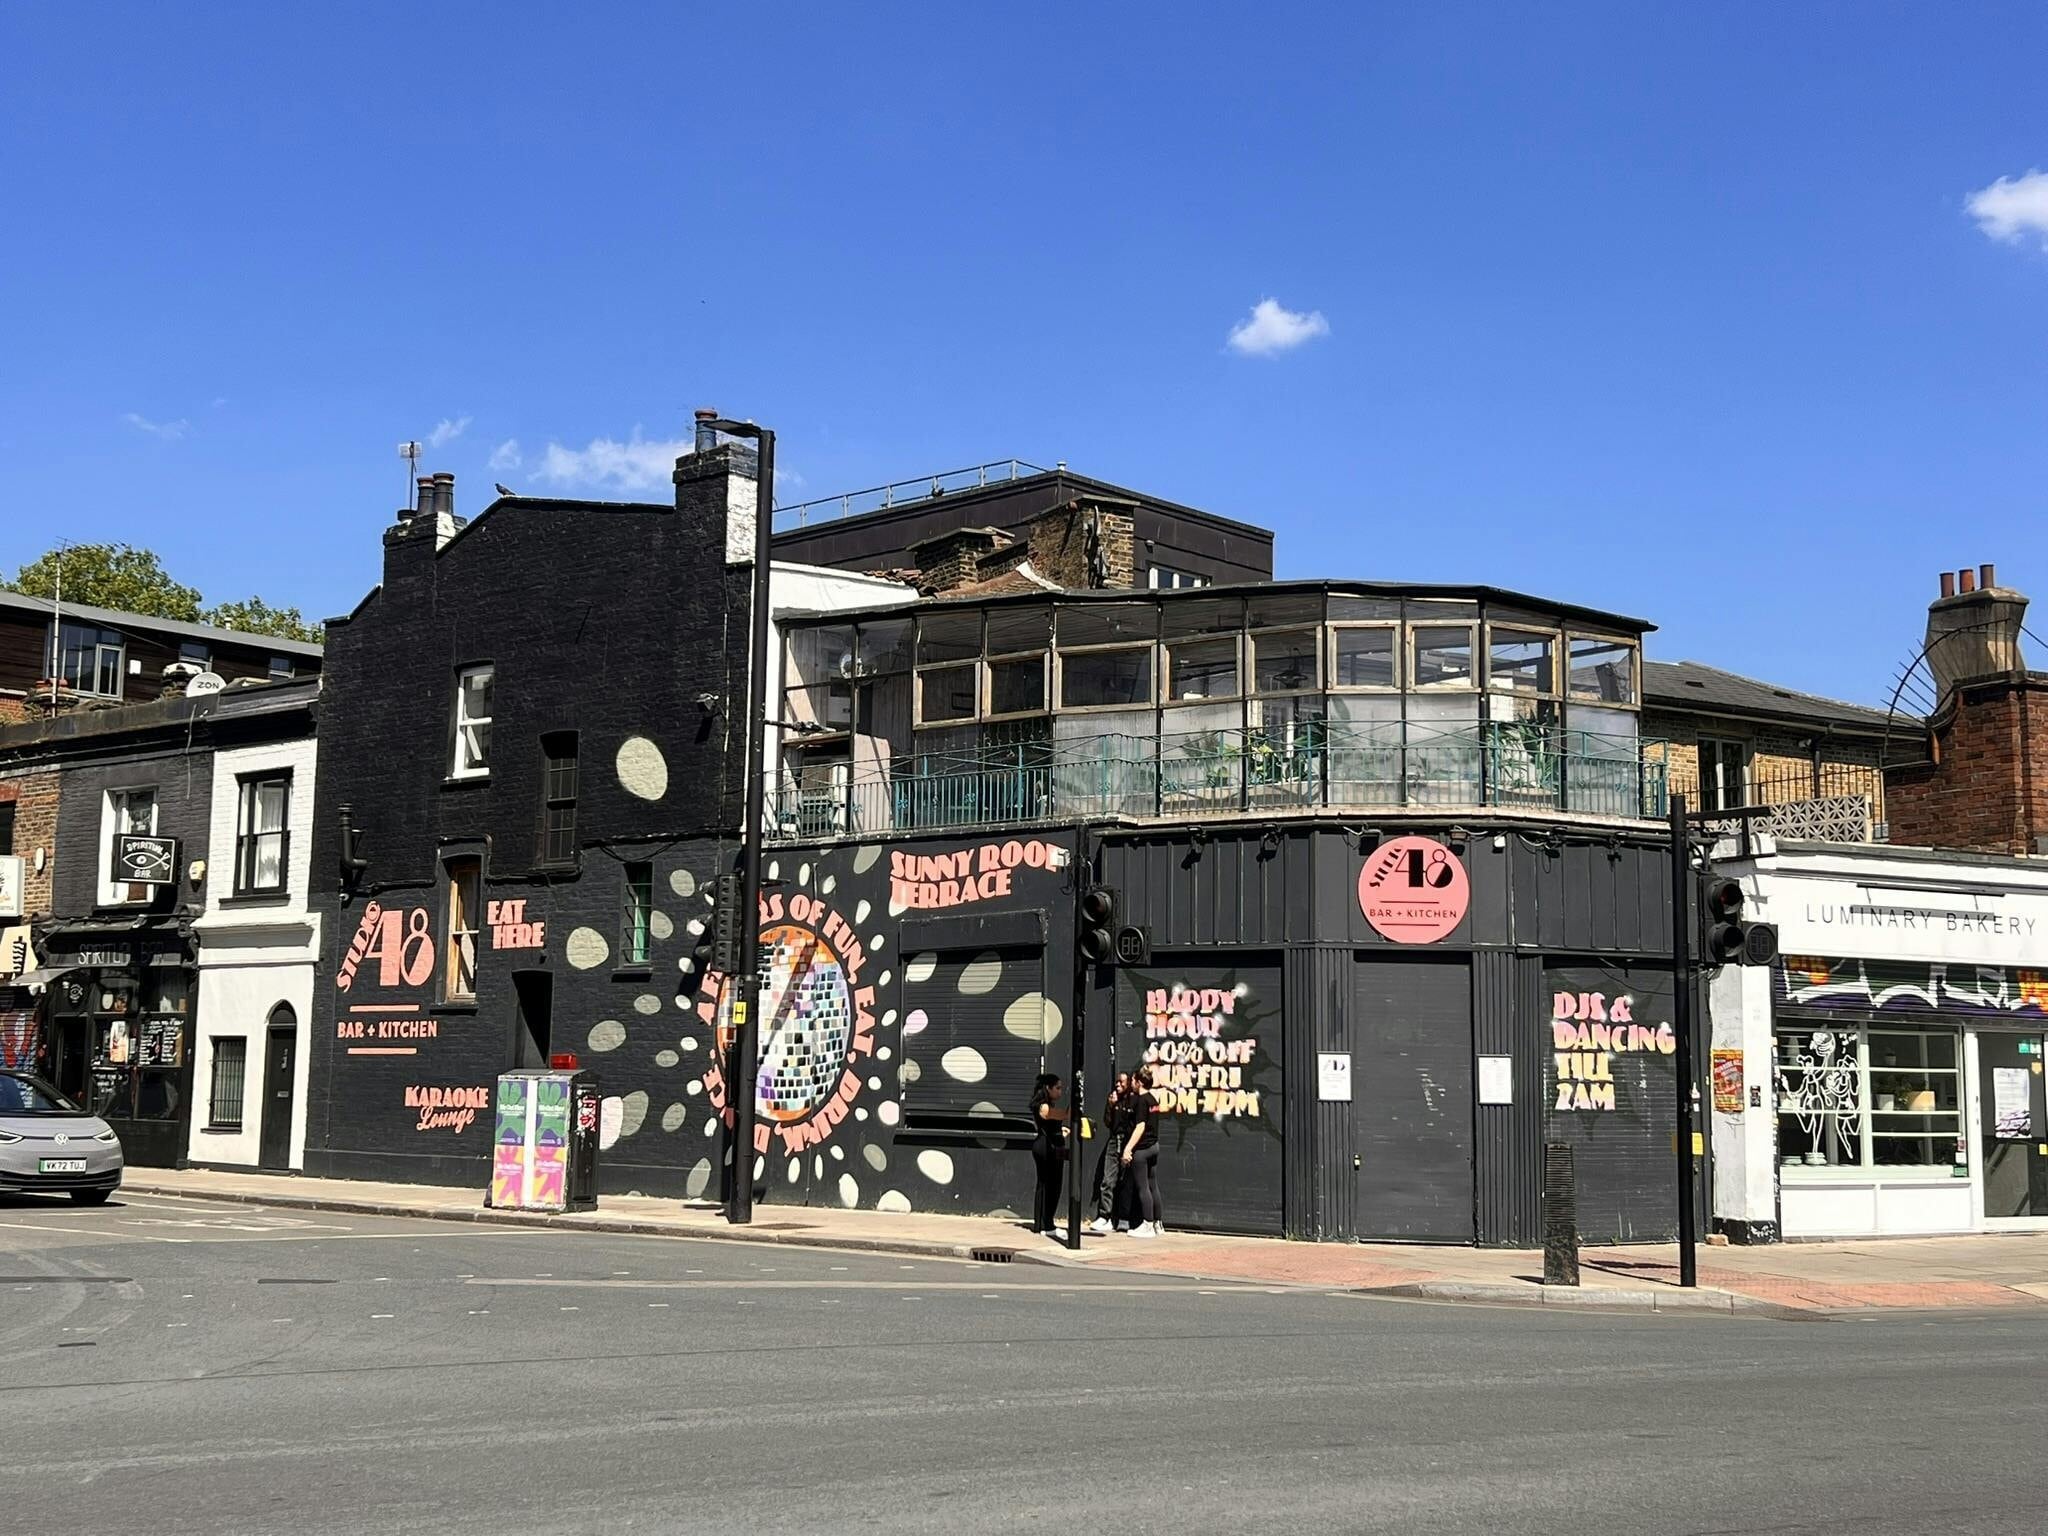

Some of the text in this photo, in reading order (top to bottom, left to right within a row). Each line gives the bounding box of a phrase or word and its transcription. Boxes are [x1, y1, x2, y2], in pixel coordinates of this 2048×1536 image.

[197, 681, 220, 690] ZON
[134, 869, 151, 878] BAR
[890, 850, 974, 882] SUNNY
[1395, 849, 1453, 888] 48
[889, 868, 1011, 909] TERRACE
[487, 899, 527, 925] EAT
[789, 893, 826, 927] OF
[1369, 908, 1392, 917] BAR
[1407, 909, 1457, 918] KITCHEN
[1806, 903, 2036, 936] LUMINARY BAKERY
[336, 900, 435, 993] STUDIO 48
[493, 922, 545, 949] HERE
[1146, 988, 1237, 1014] HAPPY
[1609, 994, 1634, 1022] &
[337, 1021, 364, 1038] BAR
[378, 1020, 437, 1038] KITCHEN
[1145, 1013, 1221, 1040] HOUR
[1552, 1020, 1677, 1054] DANCING
[1143, 1039, 1257, 1064] 50% OFF
[1554, 1053, 1614, 1081] TILL
[404, 1085, 489, 1108] KARAOKE
[1554, 1081, 1616, 1111] 2AM
[416, 1105, 475, 1134] Lounge
